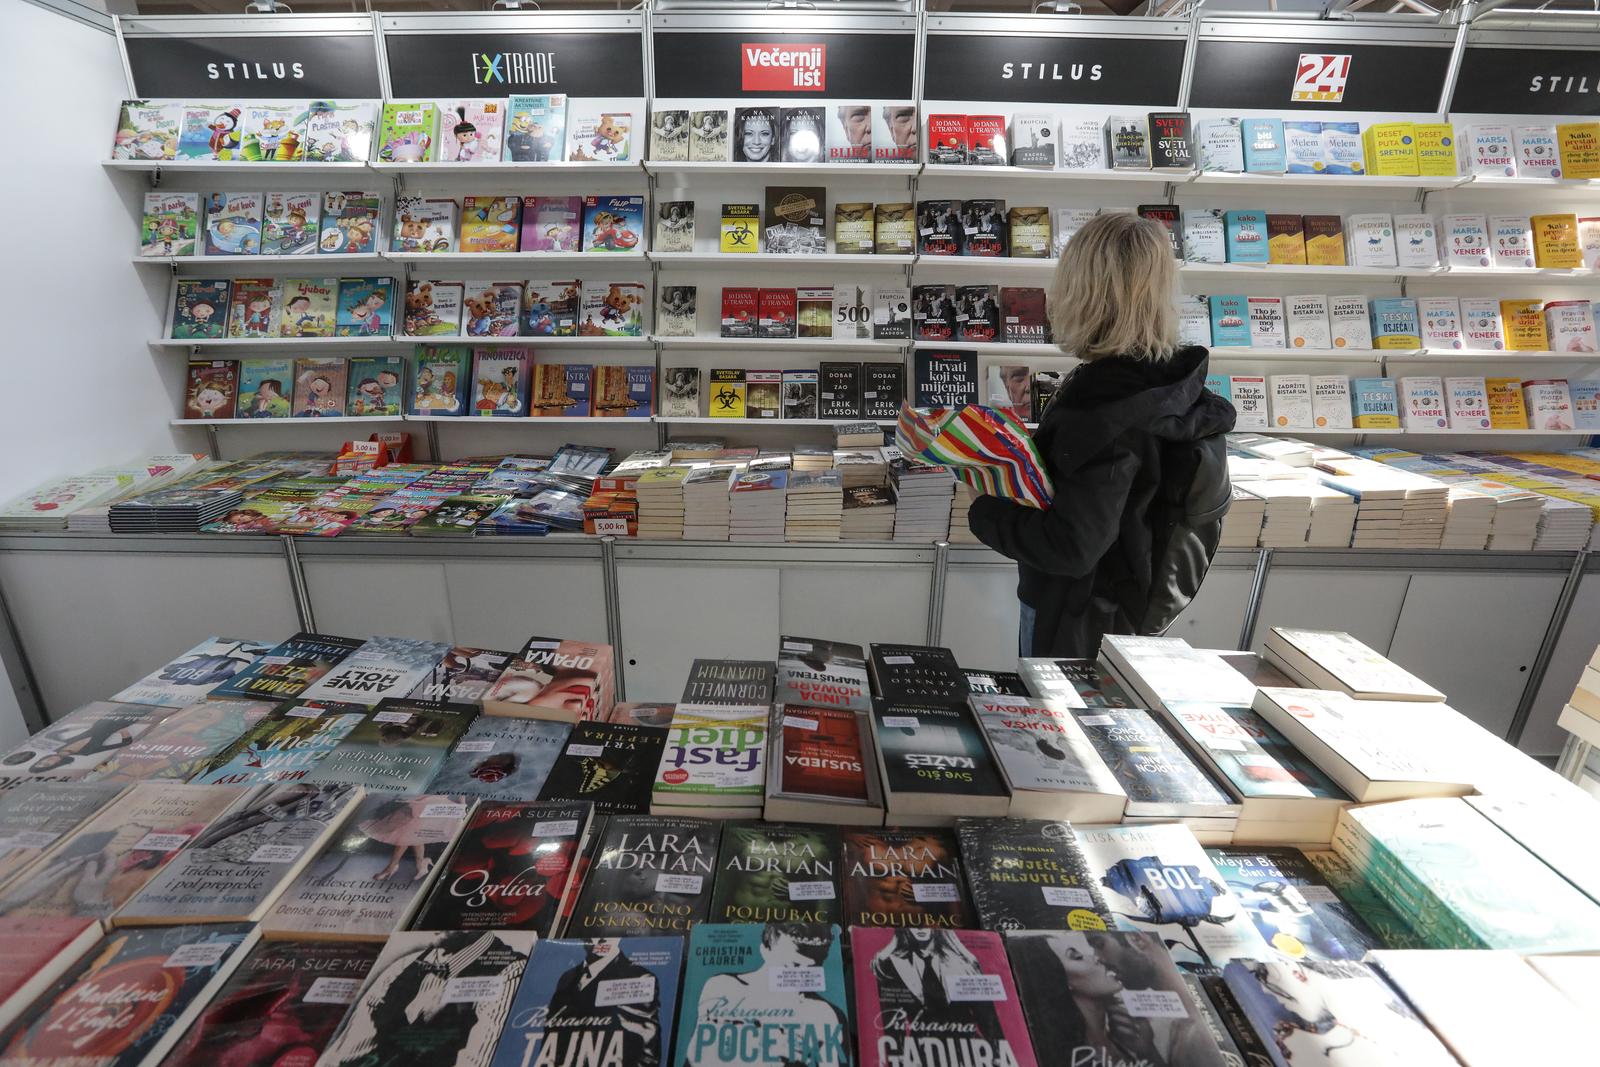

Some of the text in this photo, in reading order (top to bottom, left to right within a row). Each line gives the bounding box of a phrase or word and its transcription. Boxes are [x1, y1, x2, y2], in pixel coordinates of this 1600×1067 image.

[747, 48, 821, 70] Večernji
[208, 62, 304, 79] STILUS
[472, 52, 557, 84] EXTRADE
[1002, 63, 1103, 80] STILUS
[1296, 55, 1346, 92] 24
[793, 68, 821, 87] list
[1530, 76, 1600, 93] STIL
[1293, 92, 1341, 100] SATA
[1377, 130, 1403, 138] DESET
[1165, 149, 1191, 158] GRAL
[1379, 149, 1414, 157] SRETNIJI
[837, 306, 870, 322] 500
[1006, 325, 1044, 334] STRAH
[929, 361, 967, 372] Hrvati
[566, 371, 590, 381] ISTRA
[628, 373, 652, 382] ISTRIA
[929, 371, 966, 382] koji su
[921, 381, 975, 394] mijenjali
[1251, 387, 1261, 395] je
[931, 394, 968, 406] svijet
[598, 523, 615, 531] 5,00
[524, 650, 594, 670] OPAKA
[170, 667, 208, 679] BOL
[335, 670, 401, 684] HOLT
[697, 666, 766, 681] QUANTUM
[787, 670, 861, 686] NAPUŠTENA
[234, 677, 304, 694] DAMA U
[323, 678, 395, 693] ANNE
[423, 683, 482, 700] PASNA
[691, 682, 766, 699] CORNWELL
[788, 682, 862, 696] HOWARD
[801, 692, 850, 705] LINDA
[983, 704, 1066, 718] DOJMOVA
[1001, 720, 1067, 733] KNJIGA
[584, 731, 660, 744] LEPTIRA
[603, 741, 635, 750] VRT
[671, 728, 765, 752] diet
[666, 746, 762, 772] fast
[785, 755, 862, 773] SUSJEDA
[904, 754, 975, 770] KAŽEŠ
[917, 769, 973, 782] Sve što
[486, 809, 582, 820] TARA SUE ME
[619, 833, 703, 855] LARA
[750, 839, 816, 858] LARA
[870, 845, 937, 861] LARA
[594, 852, 714, 873] ADRIAN
[725, 856, 833, 876] ADRIAN
[1214, 855, 1304, 868] Maya Banks
[180, 864, 272, 878] Trideset dvije
[850, 861, 959, 880] ADRIAN
[990, 872, 1078, 885] NALJUTI SE
[173, 877, 201, 891] pol
[201, 878, 263, 891] prepreke
[304, 877, 358, 890] Trideset
[359, 878, 378, 890] tri
[386, 878, 412, 892] pol
[450, 866, 548, 907] Ogrlica
[1144, 868, 1203, 891] BOL
[299, 891, 394, 905] nepodopštine
[275, 904, 394, 920] Denise Grover Swank
[725, 905, 829, 924] POLJUBAC
[861, 911, 961, 928] POLJUBAC
[696, 946, 753, 957] CHRISTINA
[250, 957, 373, 972] TARA SUE ME
[703, 956, 745, 967] LAUREN
[64, 982, 169, 1005] Madeleine
[701, 997, 795, 1020] Prekrasan
[47, 1003, 135, 1031] L'Engle
[512, 1005, 612, 1029] Prekrasna
[874, 1007, 977, 1033] Prekrasna
[518, 1031, 625, 1067] TAJNA
[695, 1021, 848, 1066] POČETAK
[877, 1035, 1017, 1067] GADURA
